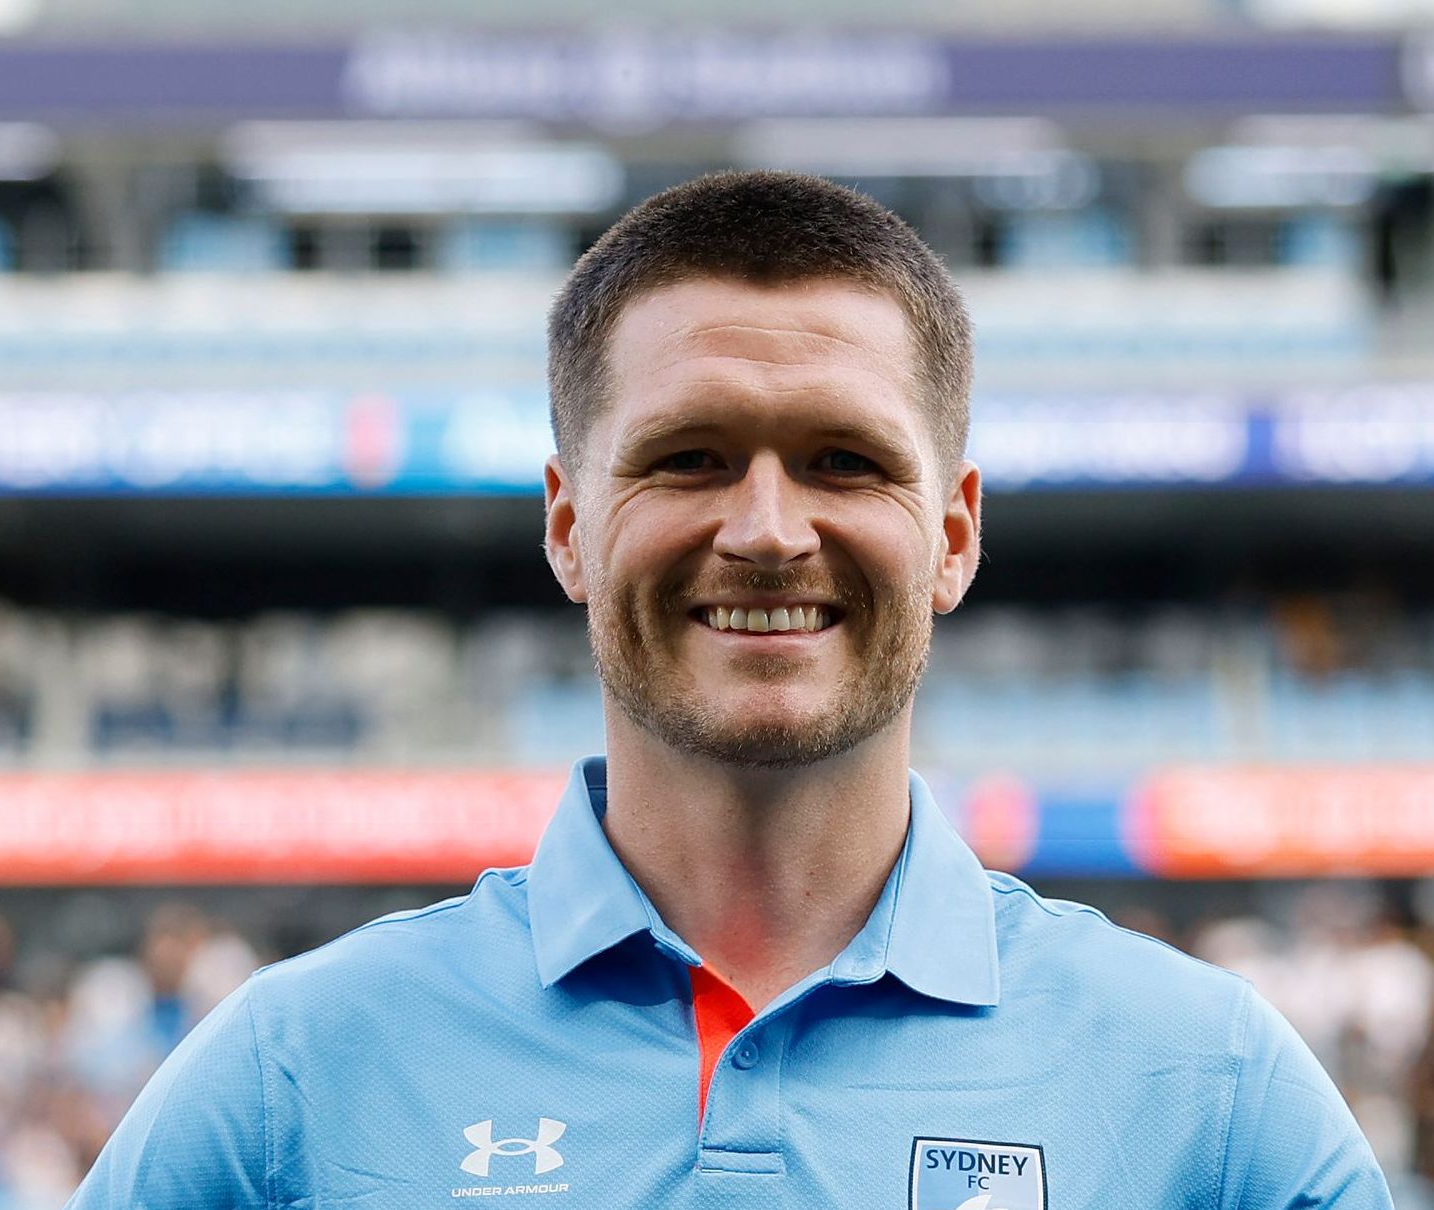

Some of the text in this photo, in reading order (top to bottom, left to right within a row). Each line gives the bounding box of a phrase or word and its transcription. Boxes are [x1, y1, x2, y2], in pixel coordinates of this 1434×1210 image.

[926, 1148, 1028, 1176] SYDNEY
[967, 1175, 990, 1190] FC
[451, 1183, 570, 1198] UNDER ARMOUR
